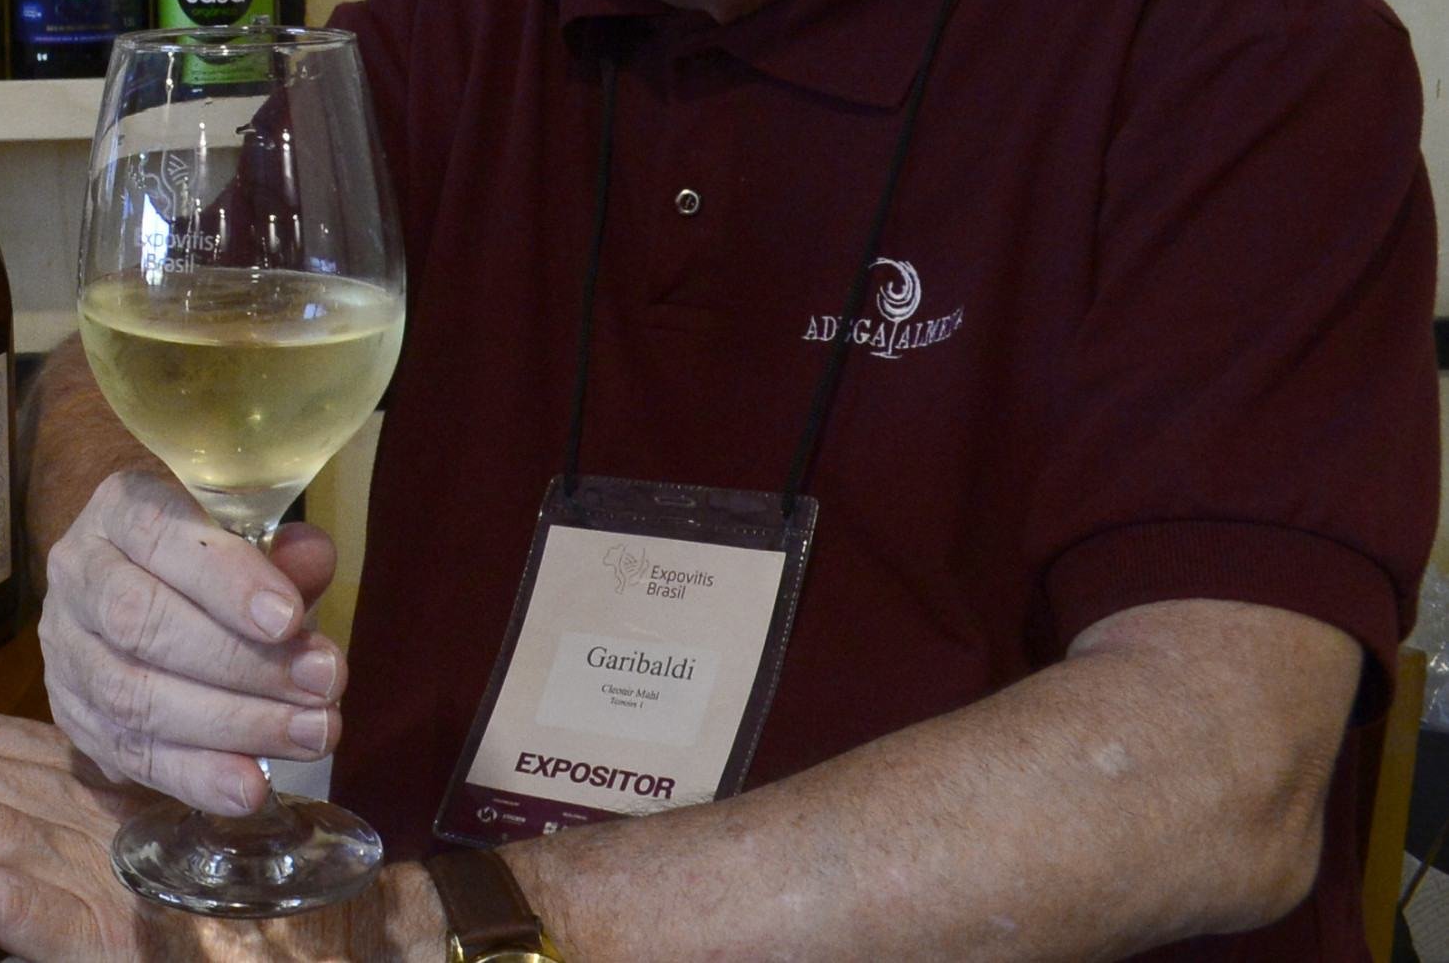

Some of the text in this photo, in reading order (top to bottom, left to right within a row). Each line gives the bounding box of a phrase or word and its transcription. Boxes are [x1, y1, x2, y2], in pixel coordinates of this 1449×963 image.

[147, 253, 195, 274] Brasil
[651, 564, 714, 587] Expovitis
[646, 582, 686, 600] Brasil
[586, 646, 696, 681] Garibaldi
[514, 752, 676, 800] EXPOSITOR
